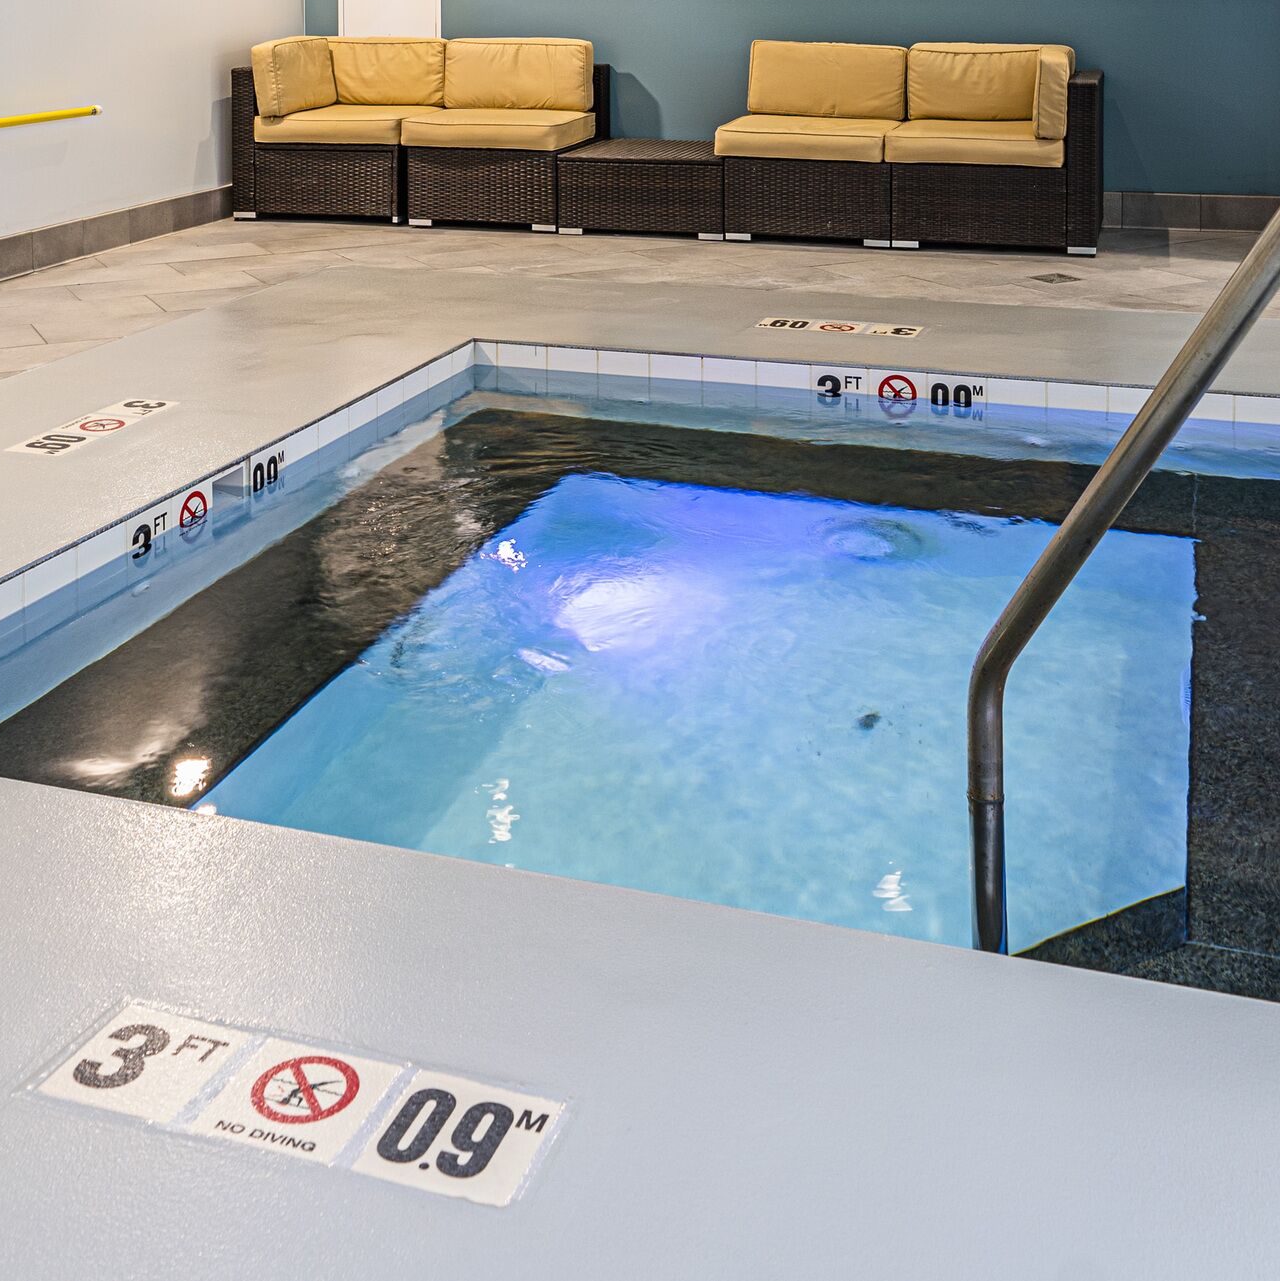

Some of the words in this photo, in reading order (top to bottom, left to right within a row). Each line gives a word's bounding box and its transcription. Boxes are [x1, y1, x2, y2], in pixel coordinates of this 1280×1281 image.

[890, 327, 917, 336] 3
[844, 376, 862, 390] FT
[972, 385, 983, 396] M
[123, 400, 167, 409] 3
[277, 450, 285, 464] M
[132, 524, 152, 560] 3
[154, 512, 167, 535] FT
[72, 1024, 170, 1089] 3
[172, 1033, 230, 1062] FT
[215, 1120, 246, 1134] NO
[248, 1129, 316, 1152] DIVING
[376, 1088, 515, 1179] 0.9
[515, 1109, 549, 1134] M
